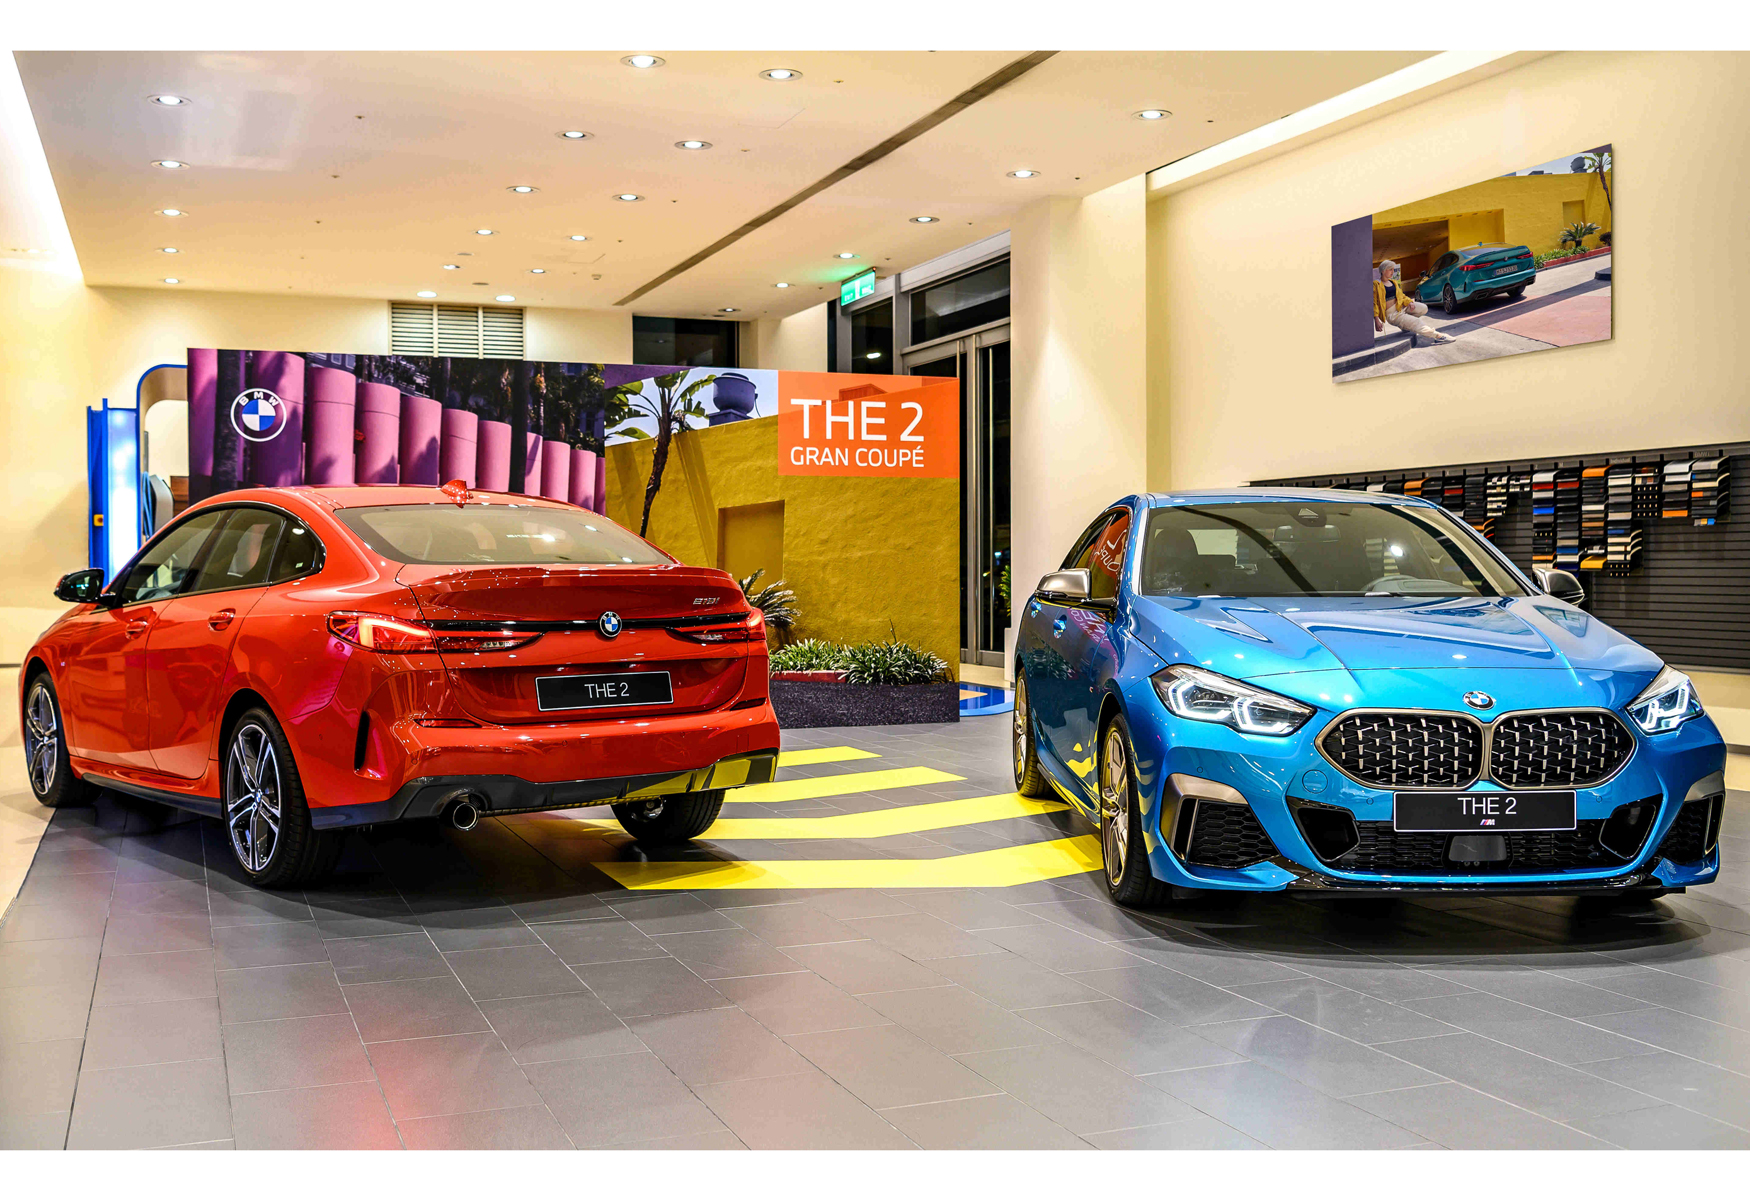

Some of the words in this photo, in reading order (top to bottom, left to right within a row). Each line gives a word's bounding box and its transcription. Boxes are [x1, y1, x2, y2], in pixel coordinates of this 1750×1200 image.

[790, 398, 887, 441] THE
[900, 401, 925, 442] 2
[790, 446, 849, 466] GRAN
[855, 445, 925, 467] COUPÉ
[584, 682, 617, 698] THE
[620, 682, 630, 697] 2
[1457, 797, 1500, 815] THE
[1505, 797, 1517, 814] 2
